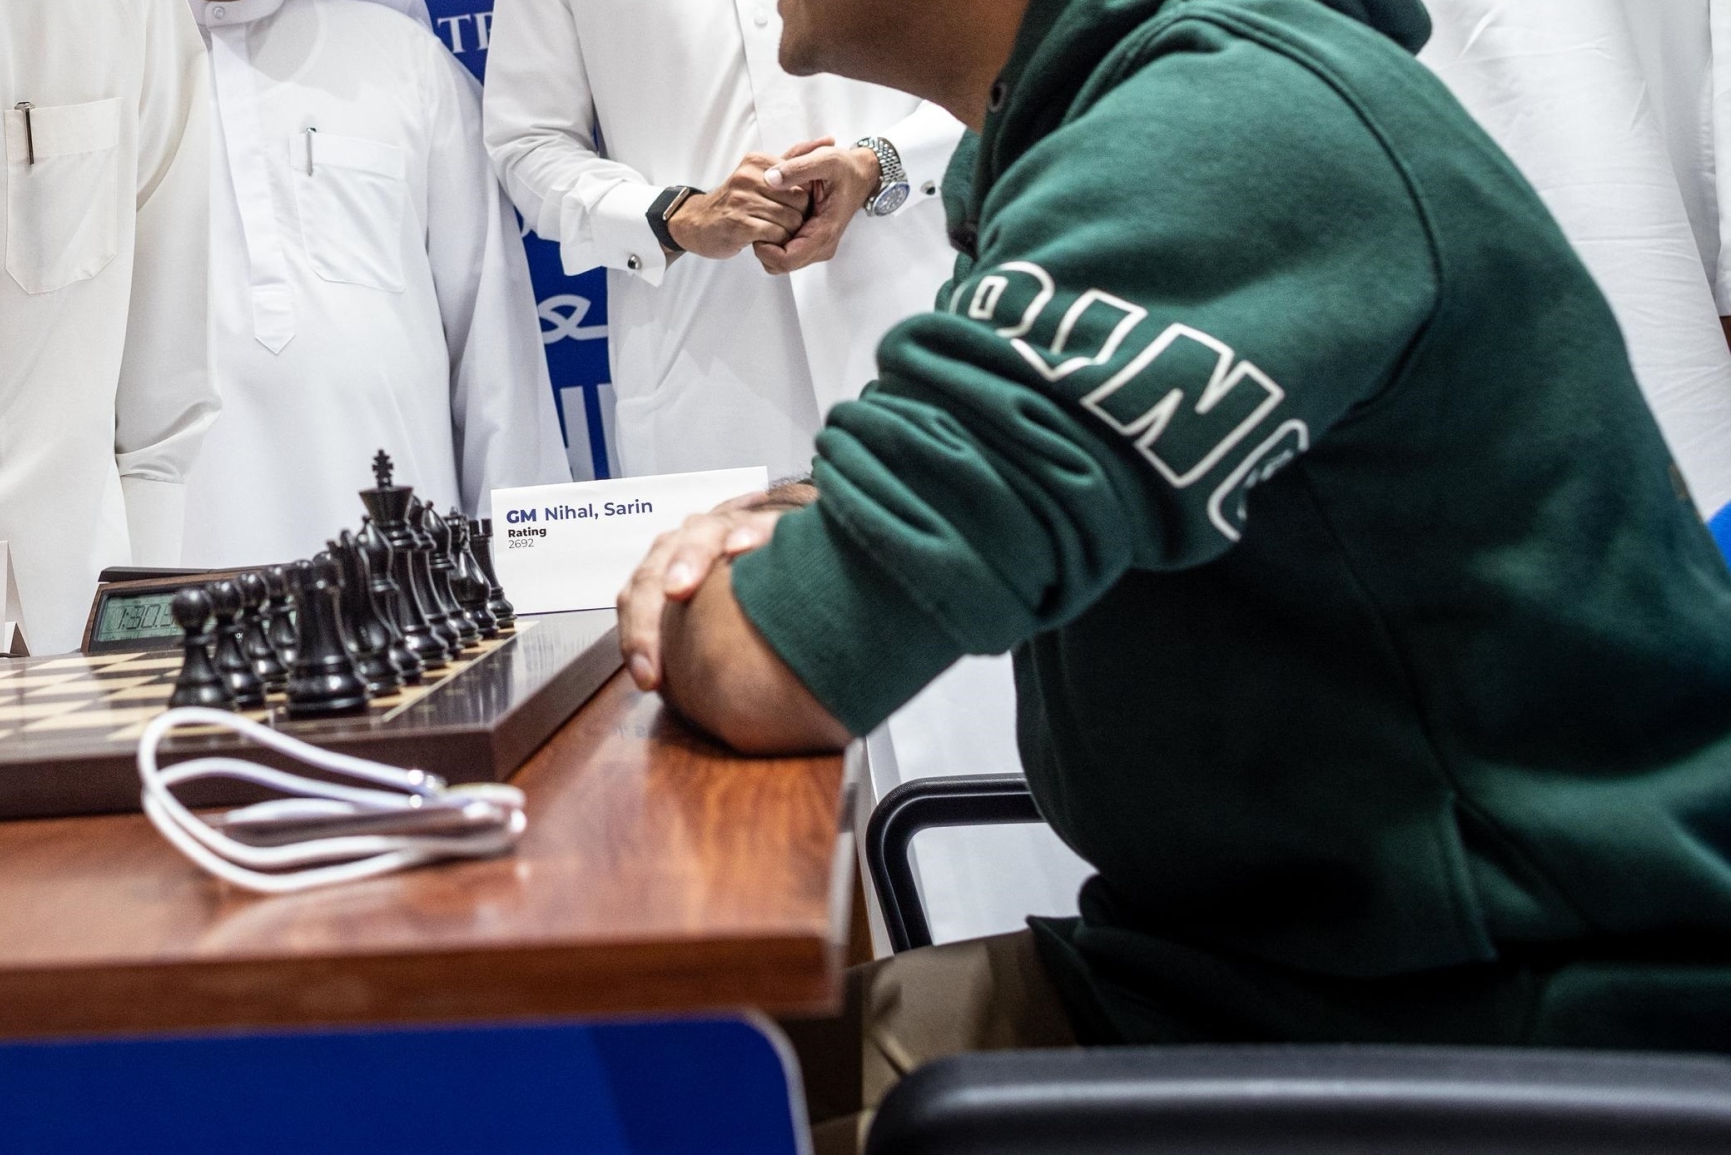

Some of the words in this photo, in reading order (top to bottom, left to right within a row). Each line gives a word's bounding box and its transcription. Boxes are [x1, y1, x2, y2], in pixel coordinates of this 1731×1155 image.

[506, 508, 537, 524] GM
[544, 503, 599, 521] Nihal,
[603, 498, 653, 517] Sarin
[508, 526, 547, 538] Rating
[508, 538, 535, 549] 2692
